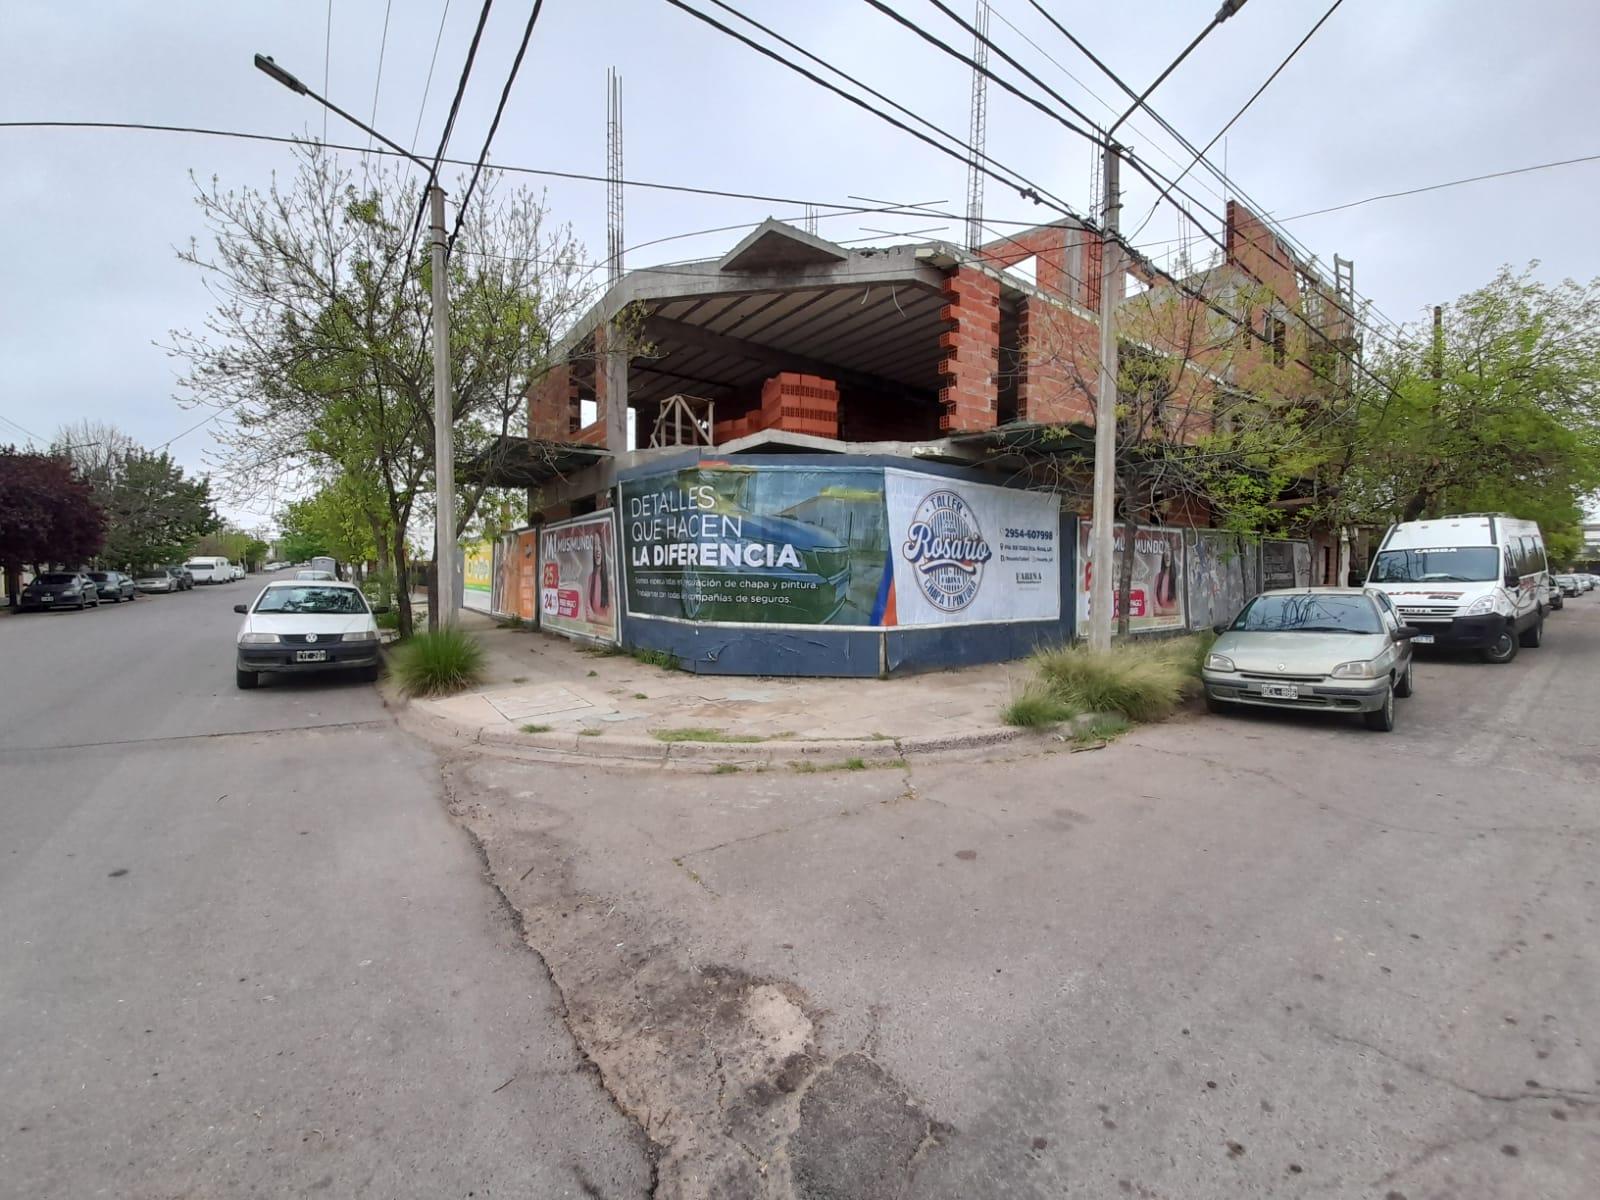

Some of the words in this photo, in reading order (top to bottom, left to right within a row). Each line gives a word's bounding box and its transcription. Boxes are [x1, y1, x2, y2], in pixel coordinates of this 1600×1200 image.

[632, 485, 715, 518] DETALLES
[930, 495, 963, 513] TALLER
[632, 518, 662, 542] QUE
[666, 515, 742, 540] HACEN
[1005, 528, 1053, 540] 2954-607998
[903, 521, 992, 562] Rosario
[632, 547, 649, 567] LA
[653, 543, 800, 568] DIFERENCIA
[724, 580, 736, 588] de
[739, 579, 769, 591] chapa
[772, 582, 778, 590] y
[780, 581, 819, 589] pintura.
[735, 594, 748, 603] de
[750, 595, 792, 605] seguros.
